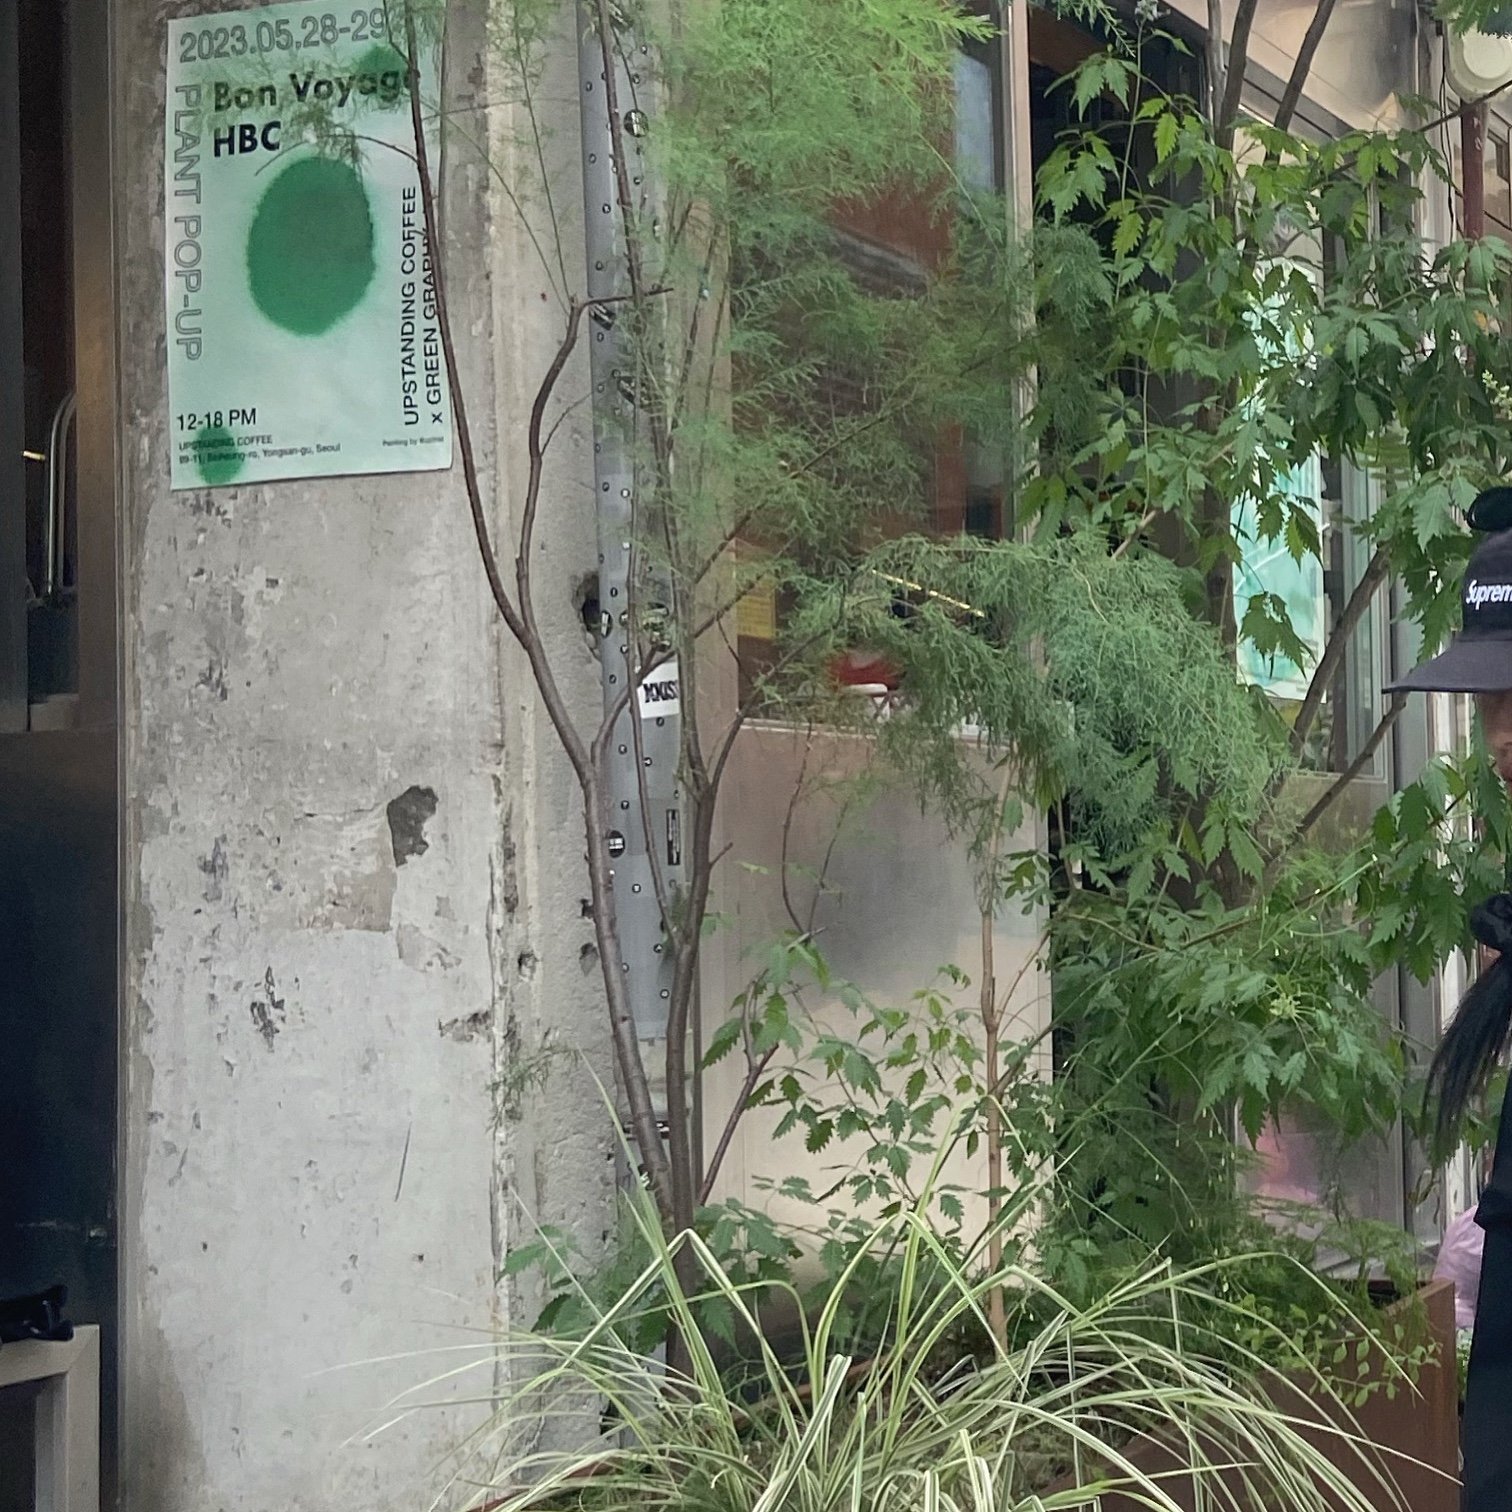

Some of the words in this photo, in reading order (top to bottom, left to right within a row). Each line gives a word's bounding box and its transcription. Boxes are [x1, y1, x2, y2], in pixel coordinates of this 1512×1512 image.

[180, 8, 387, 63] 2023.05.28-29
[214, 81, 277, 112] Bon
[174, 84, 202, 204] PLANT
[214, 121, 281, 157] HBC
[401, 186, 417, 275] COFFEE
[174, 215, 202, 361] POP-UP
[401, 281, 420, 426] UPSTANDING
[423, 327, 442, 405] GREEN
[177, 410, 223, 431] 12-18
[229, 407, 257, 427] PM
[237, 434, 273, 447] COFFEE
[316, 442, 342, 453] Seoul
